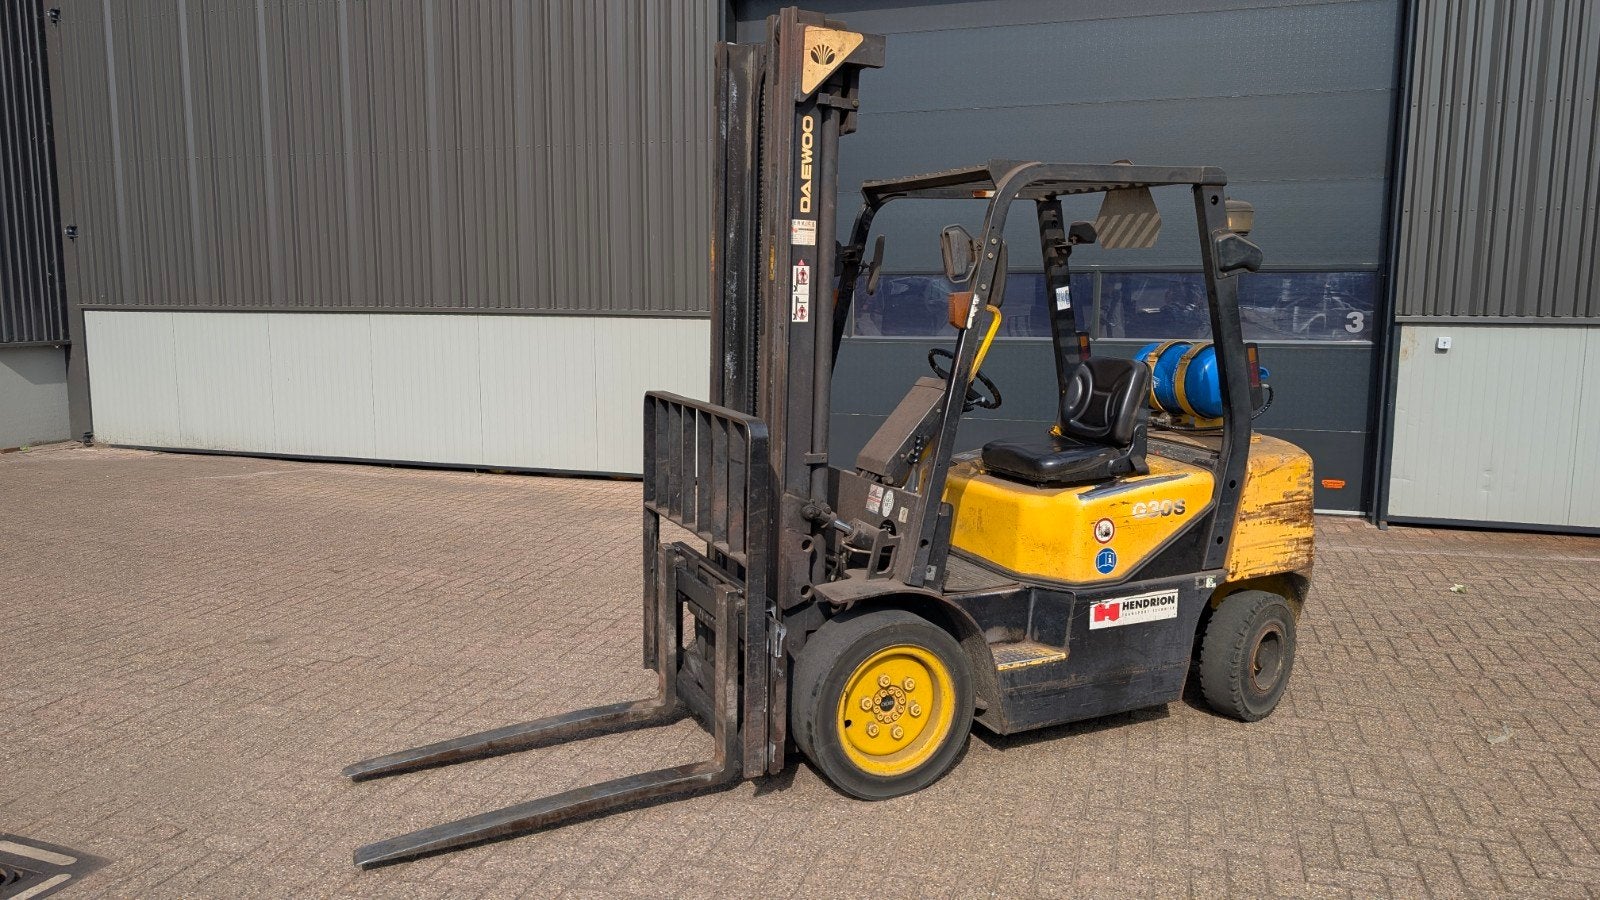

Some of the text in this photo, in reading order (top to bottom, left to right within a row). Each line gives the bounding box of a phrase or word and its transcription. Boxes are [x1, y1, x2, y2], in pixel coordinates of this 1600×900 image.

[800, 115, 814, 213] DAEWOO
[1345, 311, 1364, 333] 3
[1132, 499, 1186, 519] G30S
[1122, 595, 1175, 610] HENDRION
